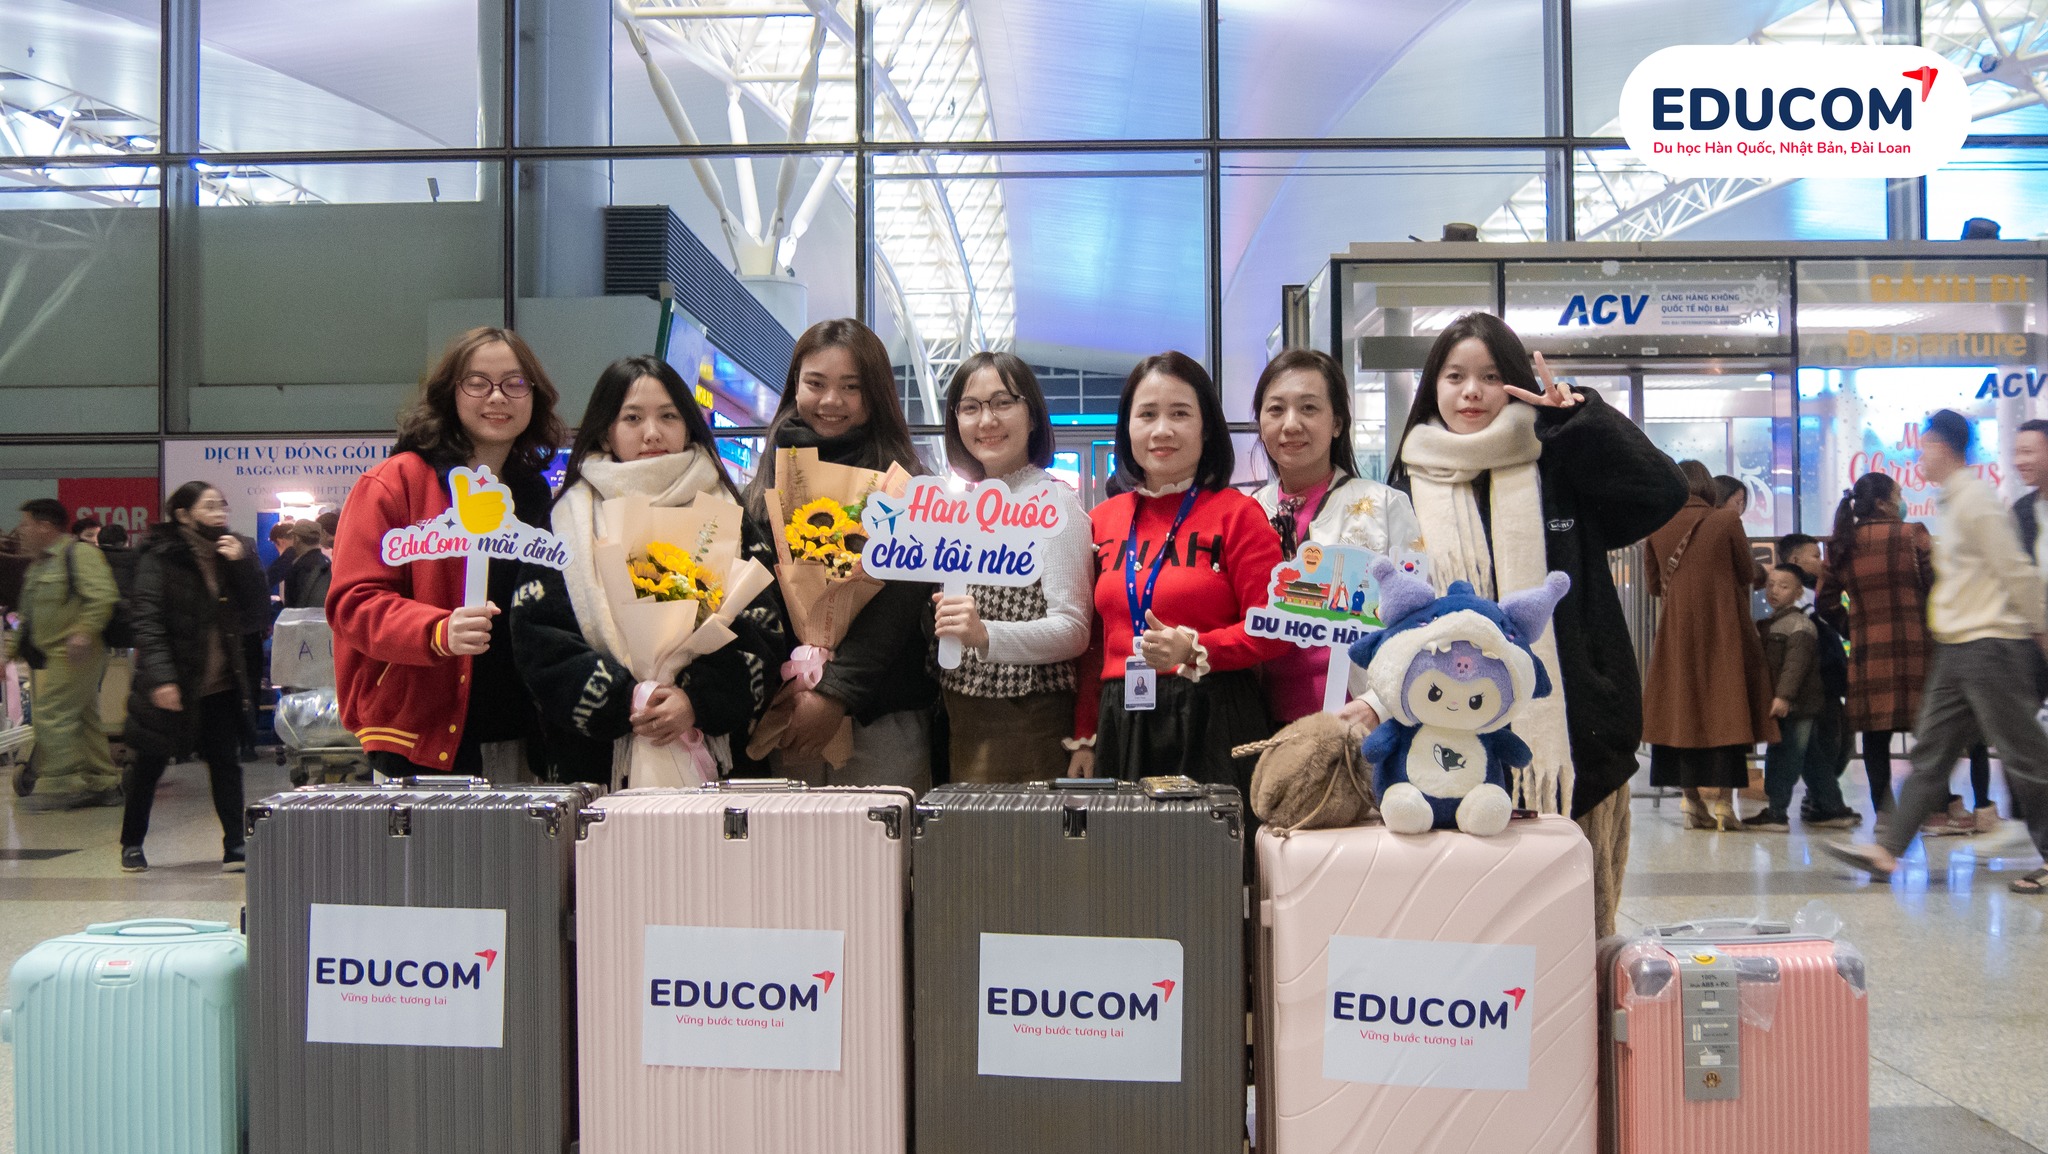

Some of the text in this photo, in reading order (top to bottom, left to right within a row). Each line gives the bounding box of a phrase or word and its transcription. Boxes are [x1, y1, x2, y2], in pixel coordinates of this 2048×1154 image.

[1558, 294, 1650, 326] ACV
[1686, 292, 1709, 301] HÀNG
[1711, 292, 1740, 301] KHÔNG
[1661, 303, 1684, 314] QUỐC
[1847, 329, 2028, 361] Departure
[1974, 373, 2048, 399] ACV
[204, 447, 250, 464] DỊCH
[255, 446, 280, 464] VỤ
[285, 442, 337, 460] ĐÓNG
[342, 442, 376, 460] GÓI
[236, 465, 299, 476] BAGGAGE
[908, 484, 1059, 533] Hàn Quốc
[388, 531, 568, 566] EduCom mãi đỉnh
[871, 534, 1036, 576] chờ tôi nhé
[1251, 615, 1280, 633] DU
[1284, 620, 1327, 643] HỌC
[316, 957, 481, 989] EDUCOM
[341, 992, 447, 1007] Vững bước tương lai
[650, 978, 818, 1011] EDUCOM
[987, 987, 1158, 1021] EDUCOM
[675, 1014, 784, 1029] Vững bước tương lai
[1333, 990, 1509, 1030] EDUCOM
[1013, 1023, 1124, 1039] Vững bước tương lai
[1359, 1029, 1474, 1048] Vững bước tương lai
